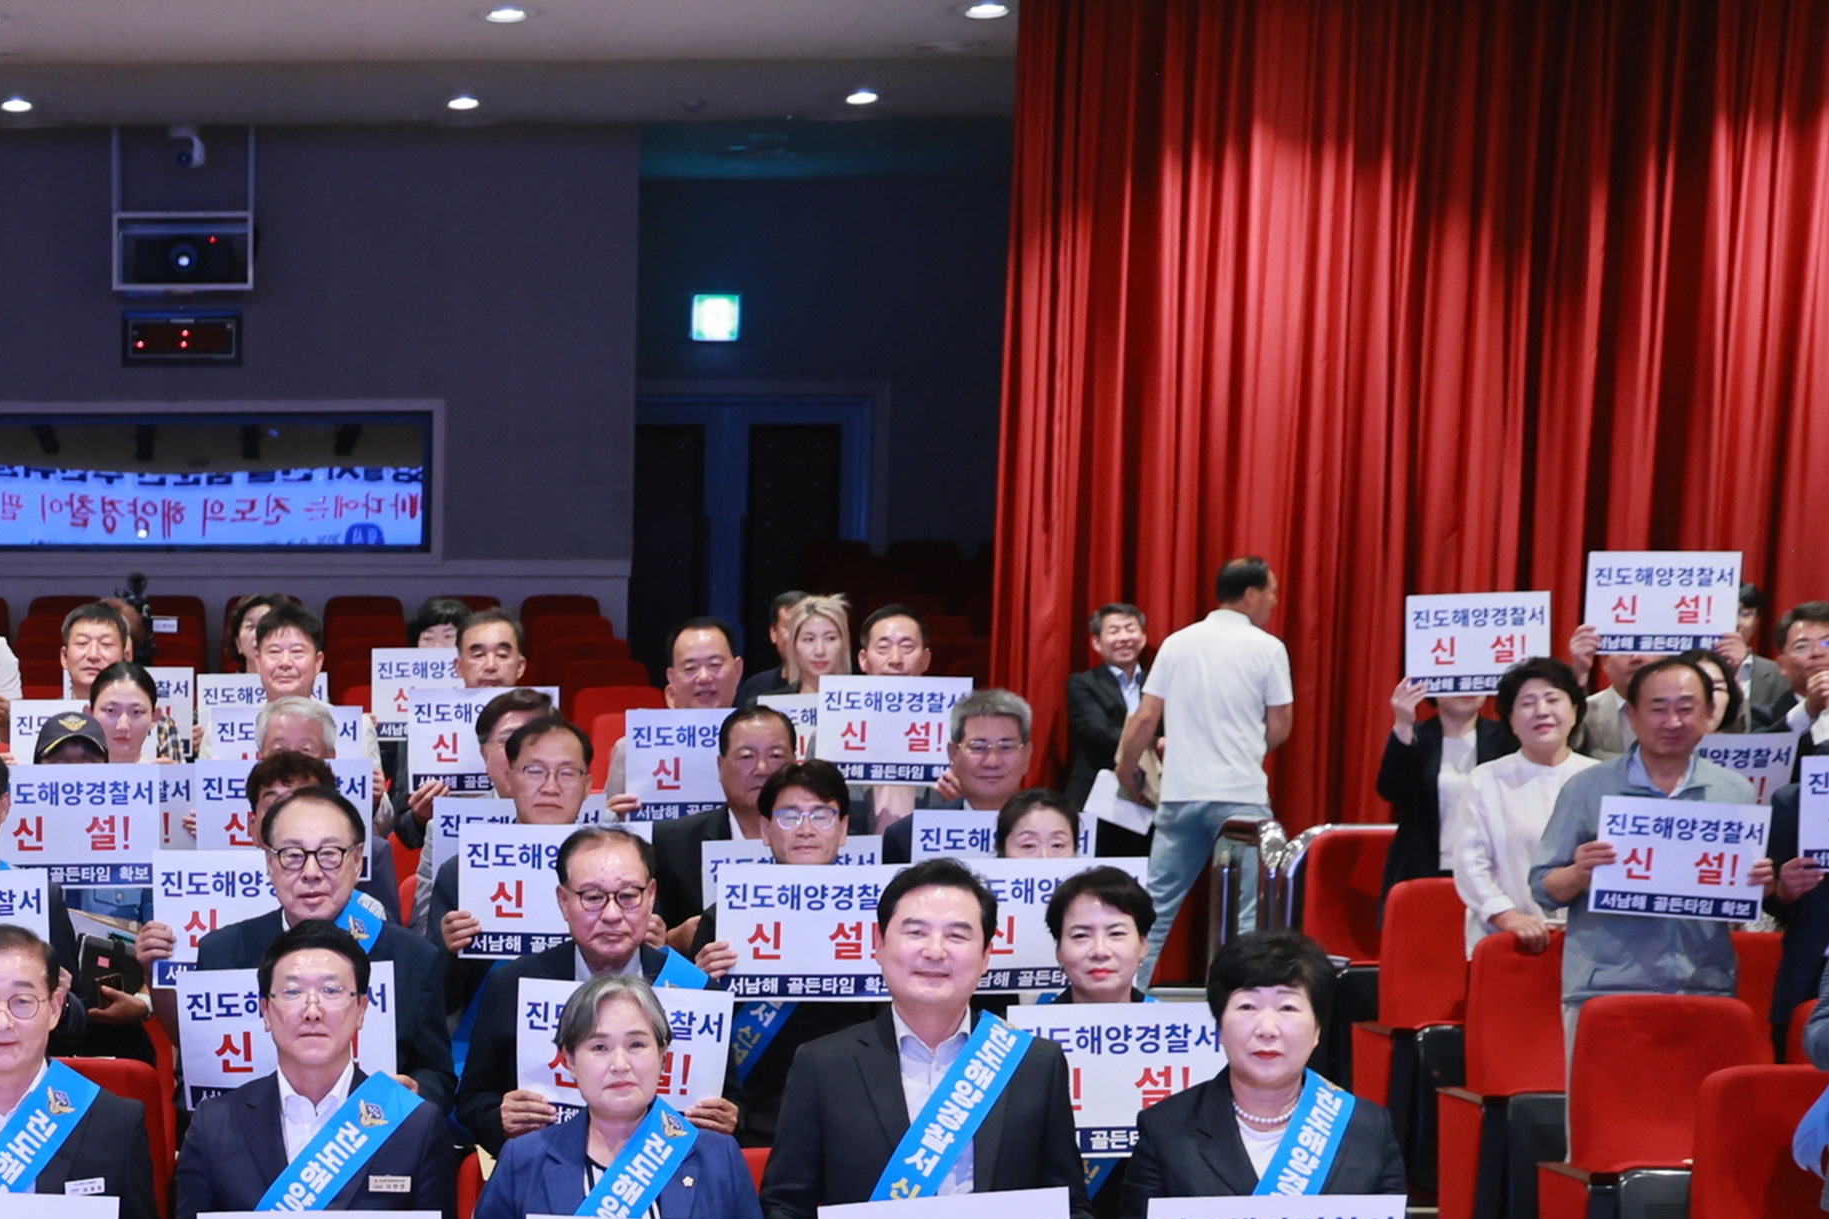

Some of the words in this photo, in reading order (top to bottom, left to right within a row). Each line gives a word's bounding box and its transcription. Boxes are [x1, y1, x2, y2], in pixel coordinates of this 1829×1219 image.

[1594, 566, 1734, 587] 진도해양경찰서
[1413, 606, 1545, 629] 진도해양경찰서
[1612, 596, 1637, 624] 신
[1674, 595, 1711, 624] 설!
[1431, 637, 1455, 665] 신
[433, 733, 459, 762] 신
[633, 725, 719, 748] 진도해양
[841, 721, 866, 751] 신
[905, 721, 943, 752] 설!
[652, 758, 681, 791] 신
[870, 765, 924, 779] 골든타임
[10, 781, 153, 806] 도해양경찰서
[13, 816, 43, 851] 신
[86, 815, 129, 851] 설!
[1607, 814, 1765, 845] 진도해양경찰서
[49, 865, 111, 882] 골든타임
[120, 865, 150, 881] 확보
[1623, 848, 1654, 879] 신
[1694, 852, 1738, 886] 설!
[490, 880, 523, 918] 신
[725, 883, 881, 911] 진도해양경찰
[1601, 893, 1646, 909] 서남해
[1653, 894, 1713, 915] 골든타임
[1721, 900, 1751, 916] 확보
[472, 934, 521, 951] 서남해
[748, 922, 781, 960] 신
[727, 976, 779, 995] 서남해
[787, 976, 855, 995] 골든타임
[214, 1031, 253, 1073] 신
[905, 1022, 1019, 1178] 진도해양경찰서
